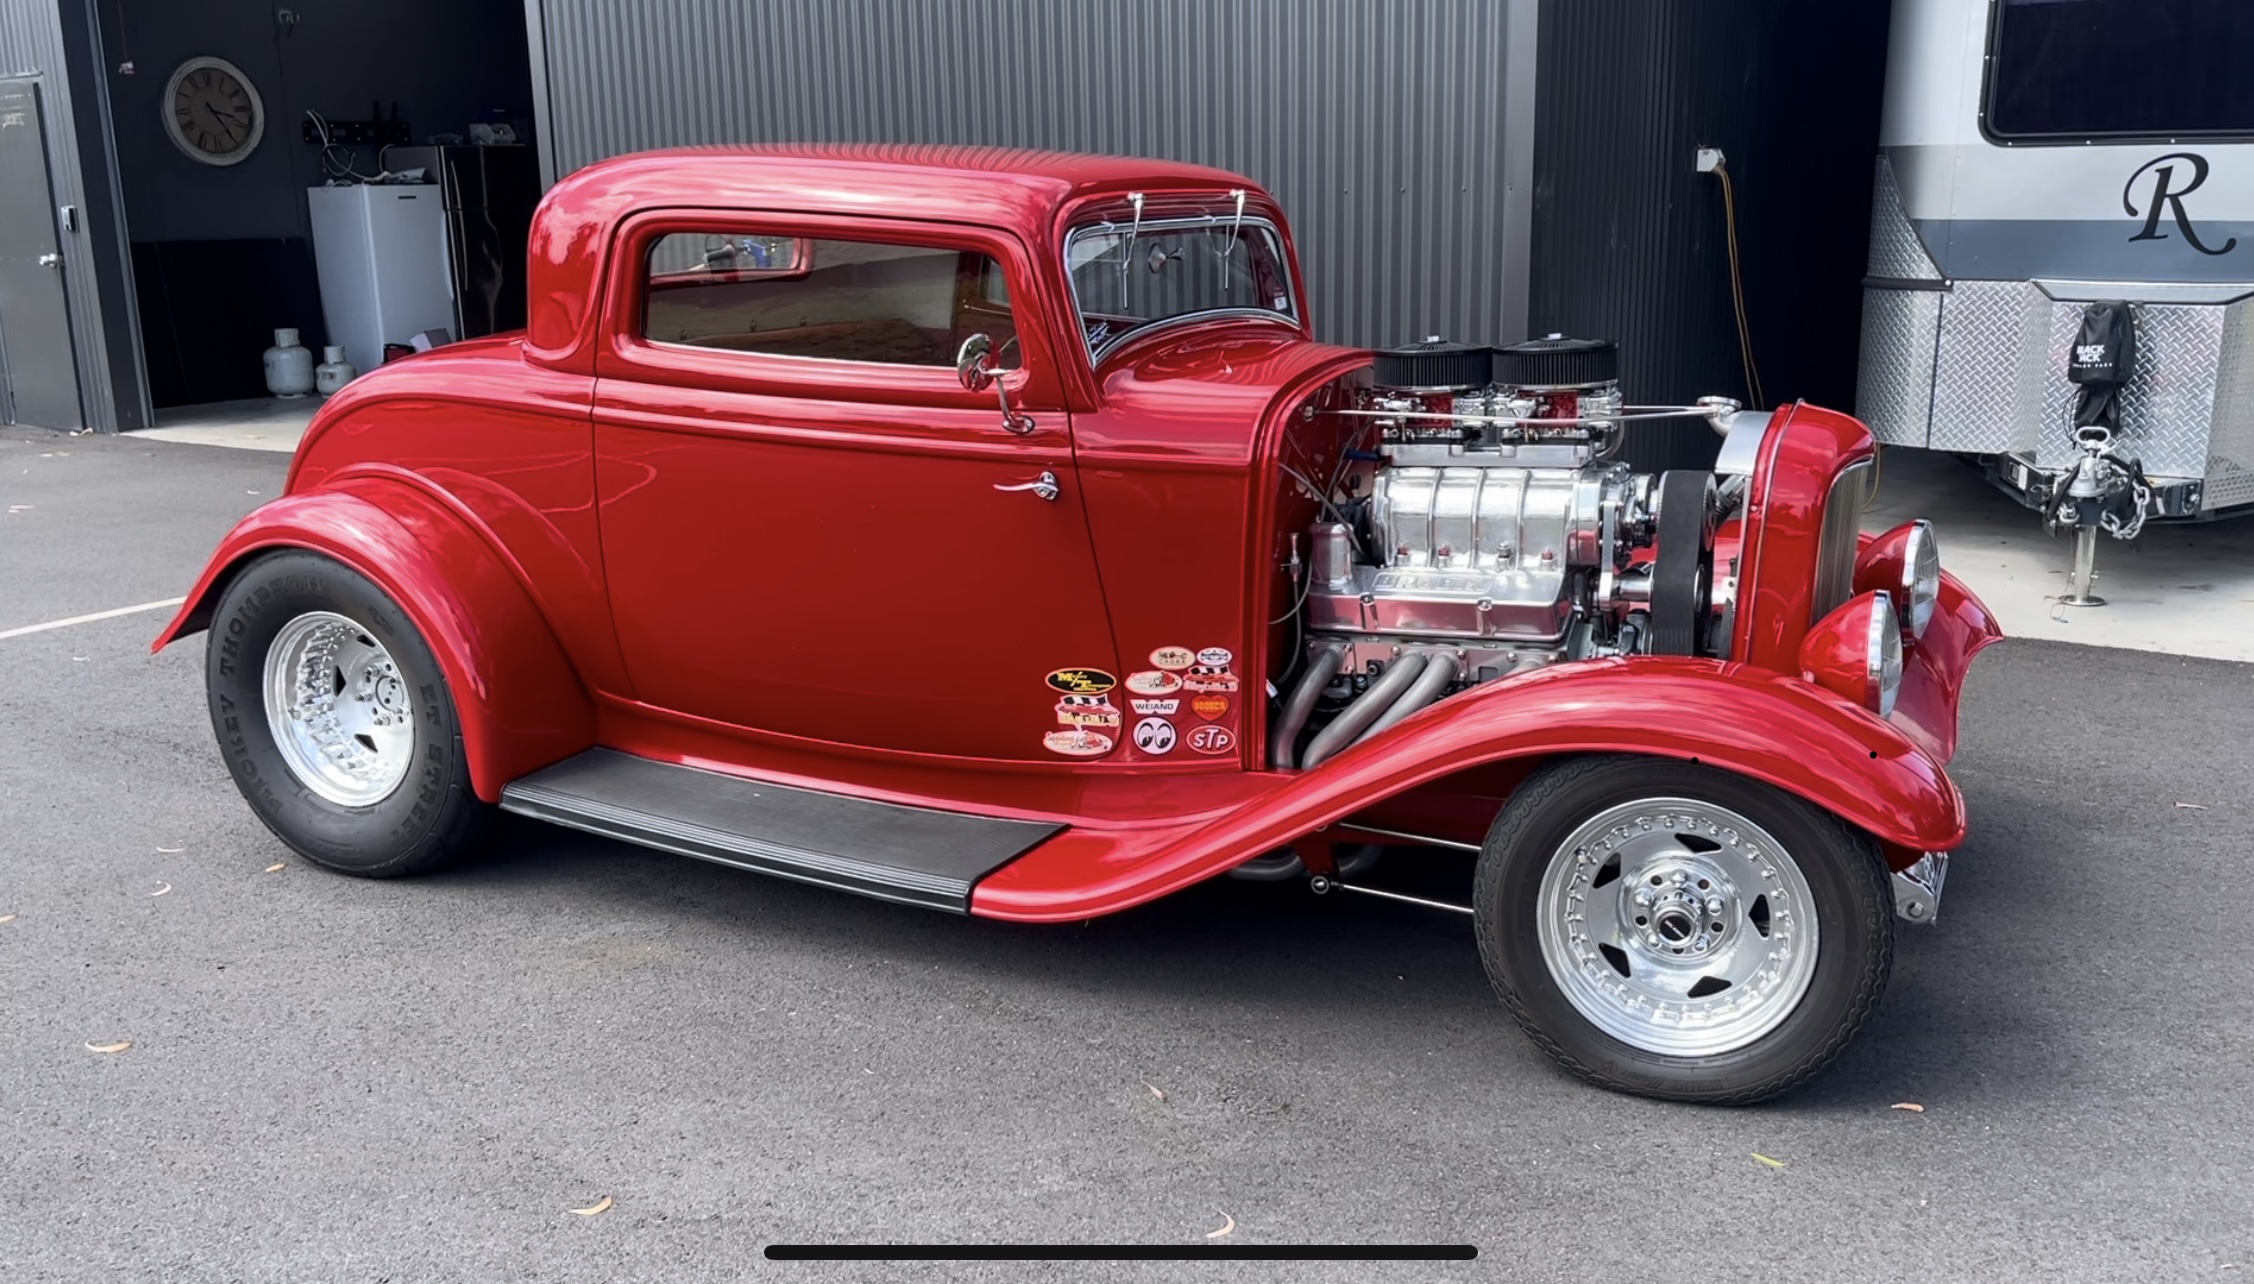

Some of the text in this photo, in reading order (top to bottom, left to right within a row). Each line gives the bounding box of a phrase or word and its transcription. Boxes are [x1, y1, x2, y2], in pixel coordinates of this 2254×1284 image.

[2123, 152, 2237, 256] R
[219, 575, 324, 678] THOMPSON
[1135, 702, 1174, 711] WEIAND
[1193, 729, 1230, 751] STP
[390, 683, 444, 849] ET STREET
